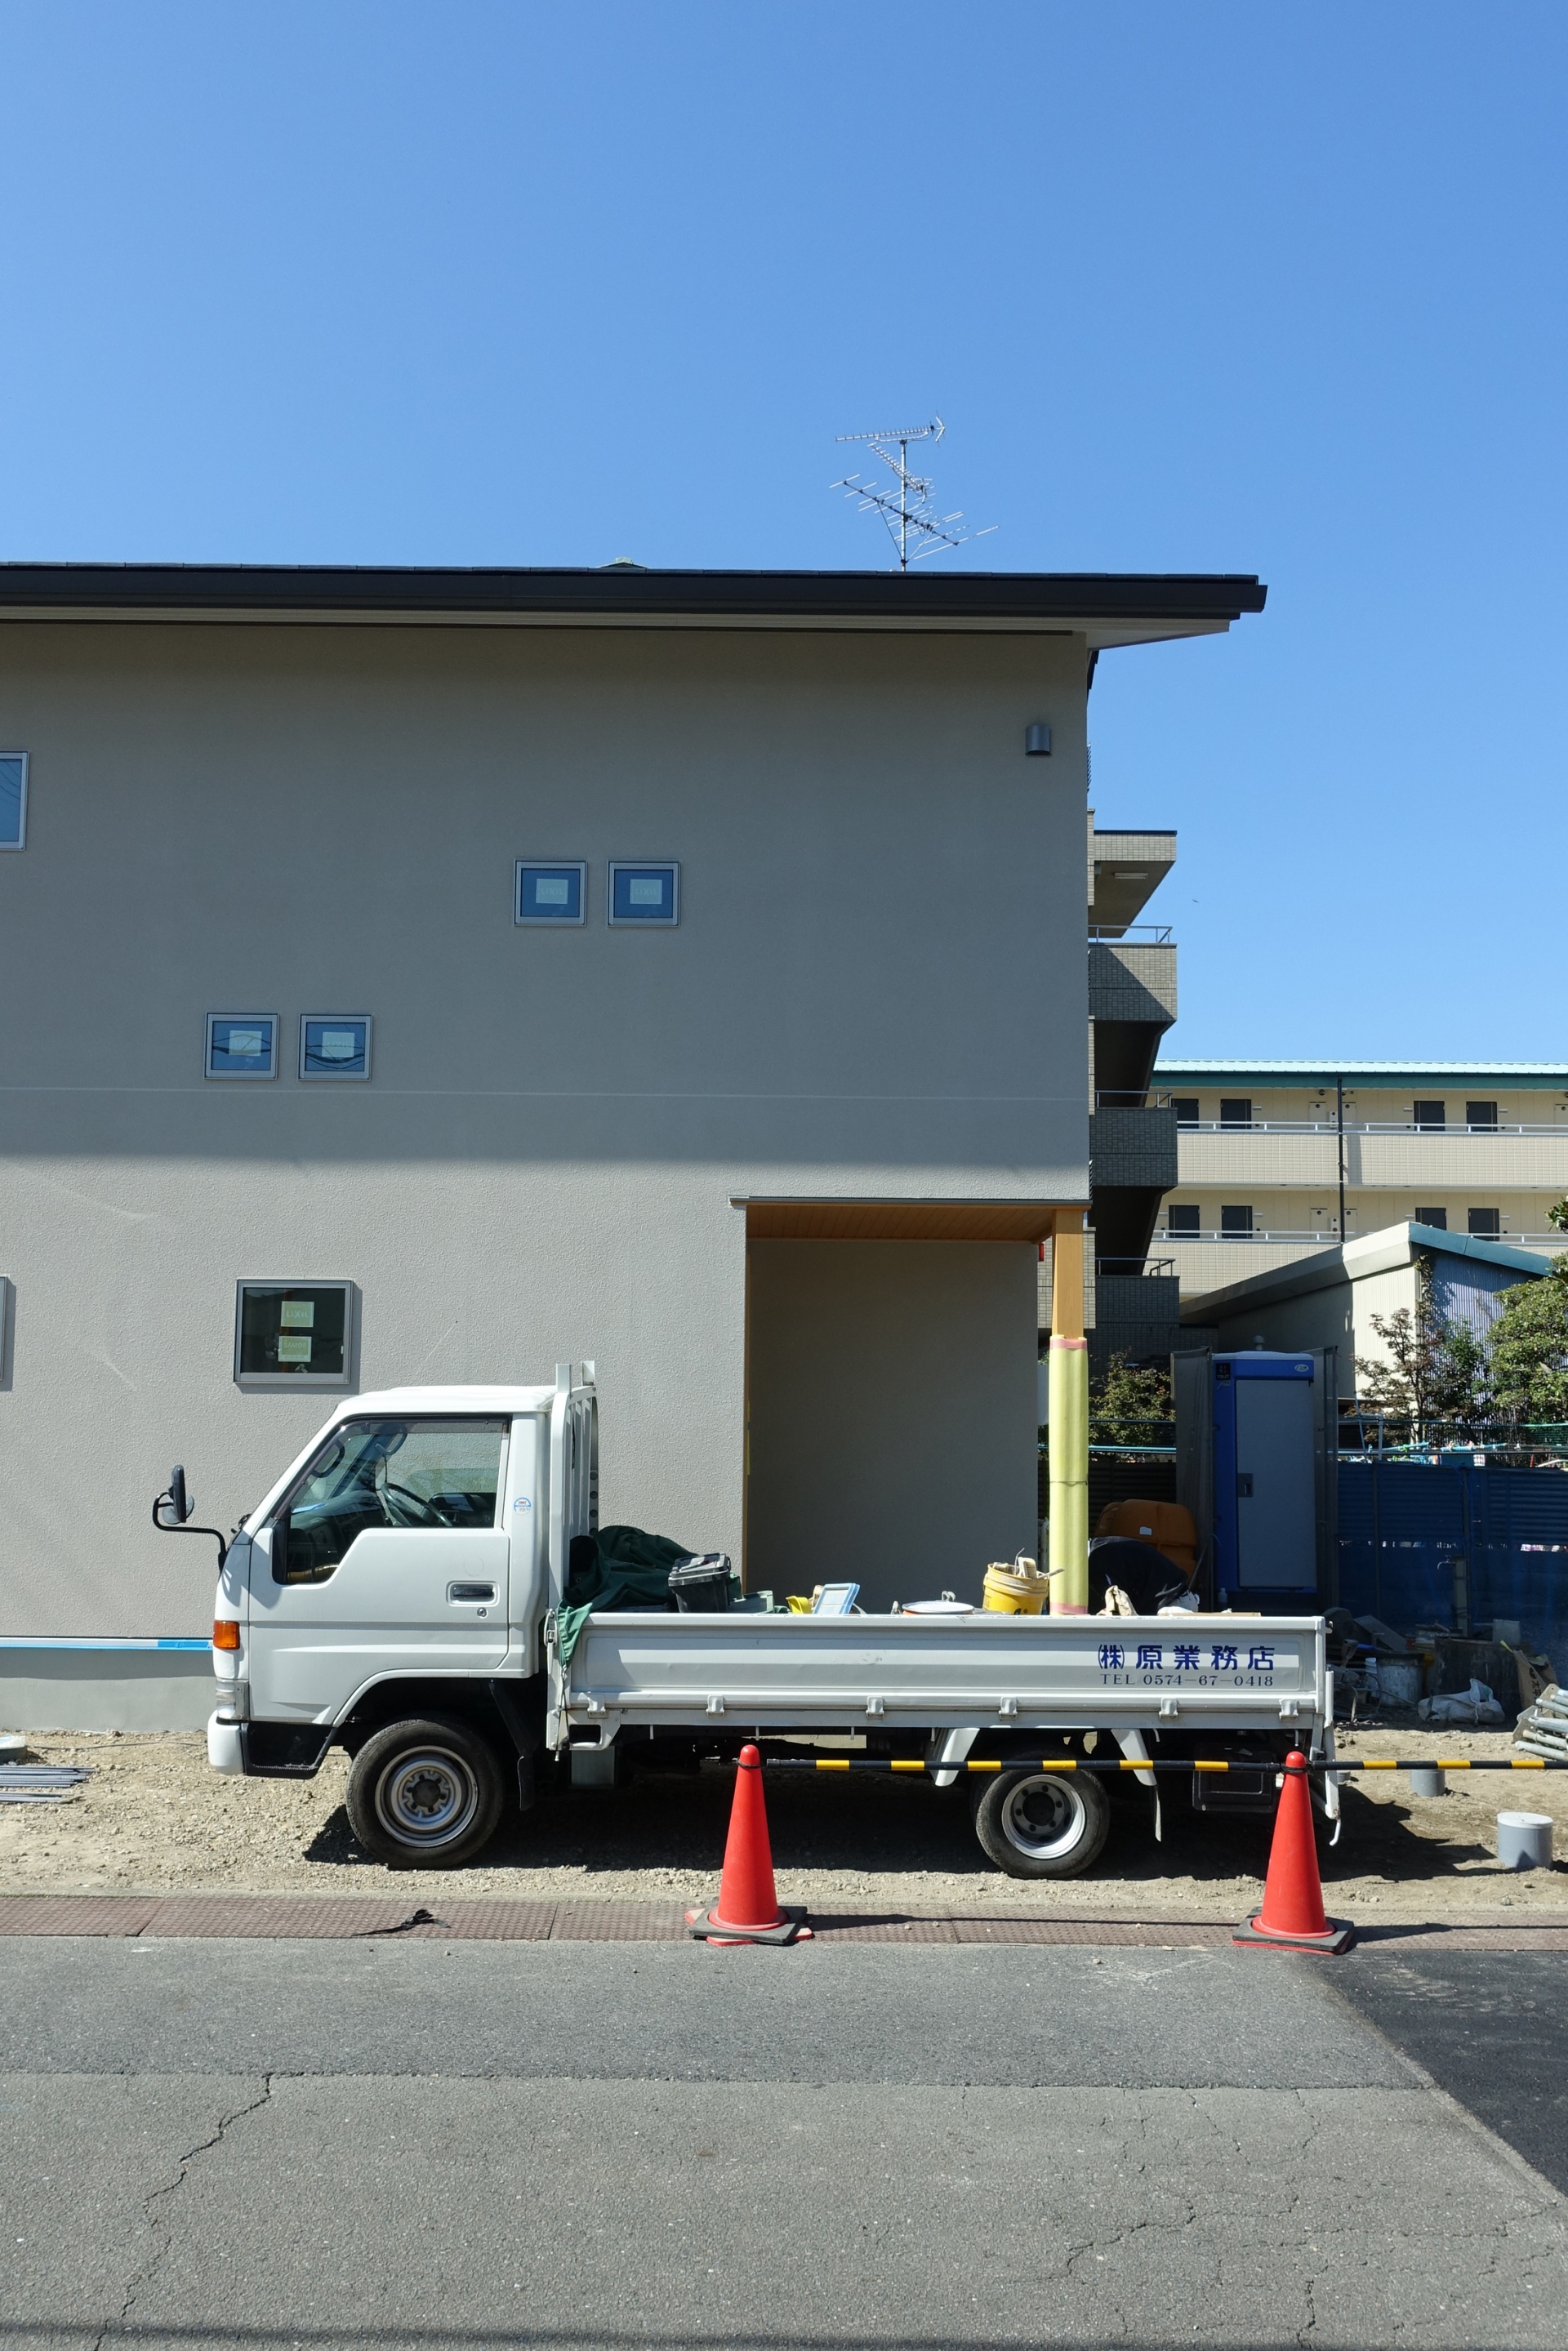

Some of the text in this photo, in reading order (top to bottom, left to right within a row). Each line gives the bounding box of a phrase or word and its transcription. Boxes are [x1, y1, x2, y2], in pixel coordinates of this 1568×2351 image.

[286, 1310, 310, 1319] LIXIL
[1098, 1645, 1275, 1671] (株)原業務店
[1100, 1674, 1273, 1686] TEL 0574-67-0418
